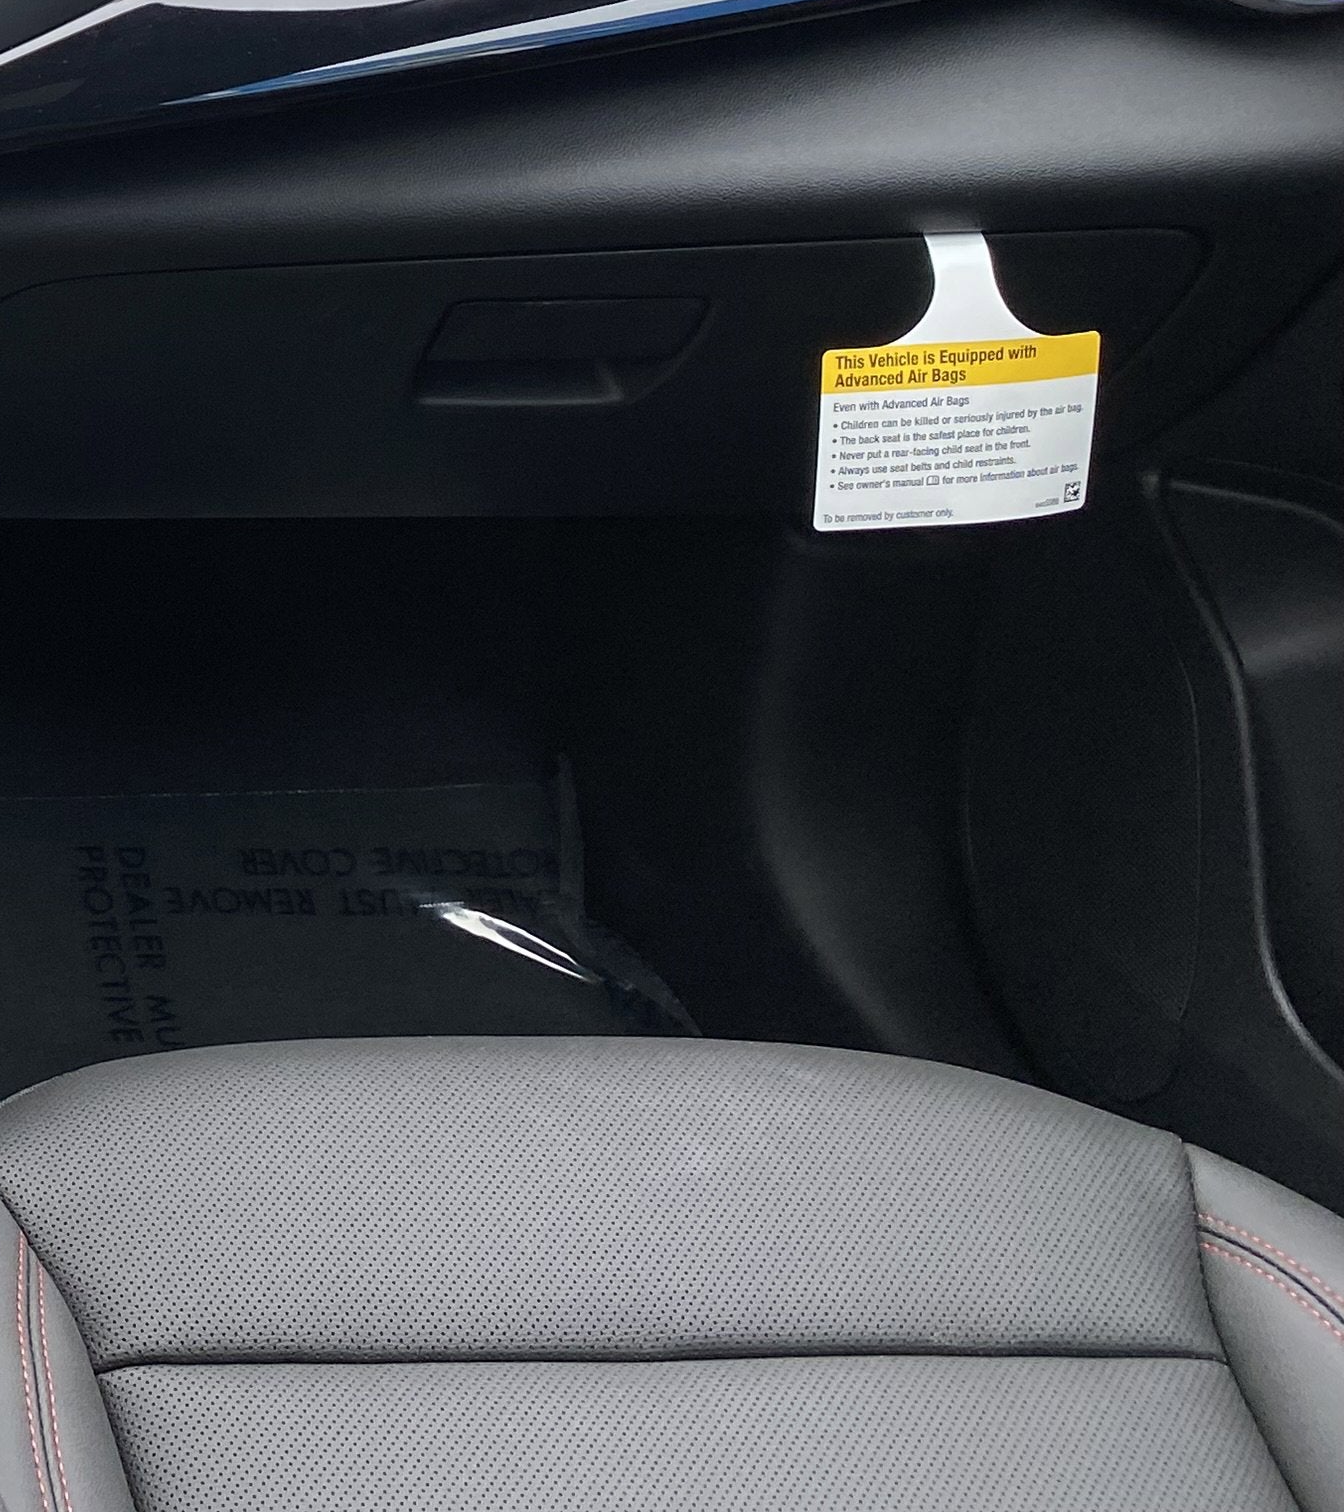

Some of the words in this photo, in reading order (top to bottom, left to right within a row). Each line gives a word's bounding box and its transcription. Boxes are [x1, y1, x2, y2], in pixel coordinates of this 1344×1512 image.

[835, 354, 865, 370] This
[869, 351, 919, 368] Vehicle
[923, 350, 935, 365] is
[939, 346, 1004, 366] Equipped
[1008, 344, 1037, 360] with
[834, 370, 904, 388] Advanced
[908, 368, 928, 384] Air
[932, 368, 967, 384] Bags
[833, 402, 856, 413] Even
[859, 400, 880, 411] with
[882, 397, 929, 410] Advanced
[930, 396, 945, 407] Air
[946, 395, 970, 407] Bags
[840, 419, 879, 430] Children
[881, 419, 899, 428] can
[900, 417, 912, 427] be
[915, 416, 940, 426] killed
[941, 416, 952, 425] or
[953, 412, 994, 424] seriously
[995, 408, 1025, 422] injured
[1027, 408, 1038, 420] by
[1039, 407, 1053, 417] the
[839, 435, 857, 446] The
[858, 434, 880, 445] back
[881, 433, 901, 444] seat
[902, 432, 911, 442] is
[912, 431, 927, 441] the
[928, 429, 956, 440] safest
[957, 429, 981, 440] place
[982, 428, 994, 437] for
[839, 450, 866, 461] Never
[867, 449, 882, 461] put
[891, 446, 940, 458] rear-facing
[941, 444, 963, 455] child
[964, 443, 983, 453] seat
[984, 442, 993, 451] in
[994, 441, 1008, 450] the
[837, 465, 870, 476] Always
[871, 465, 888, 474] use
[889, 463, 909, 473] seat
[910, 462, 932, 472] belts
[934, 460, 951, 470] and
[952, 458, 974, 469] child
[837, 481, 853, 491] See
[856, 479, 891, 489] owner's
[892, 476, 924, 488] manual
[942, 475, 955, 485] for
[955, 475, 979, 485] more
[979, 469, 1026, 482] information
[1026, 467, 1049, 478] about
[823, 513, 833, 524] To
[834, 512, 846, 523] be
[846, 511, 883, 522] removed
[884, 511, 895, 522] by
[895, 509, 934, 520] customer
[117, 846, 167, 970] DEALER
[75, 845, 146, 1042] PROTECTIVE
